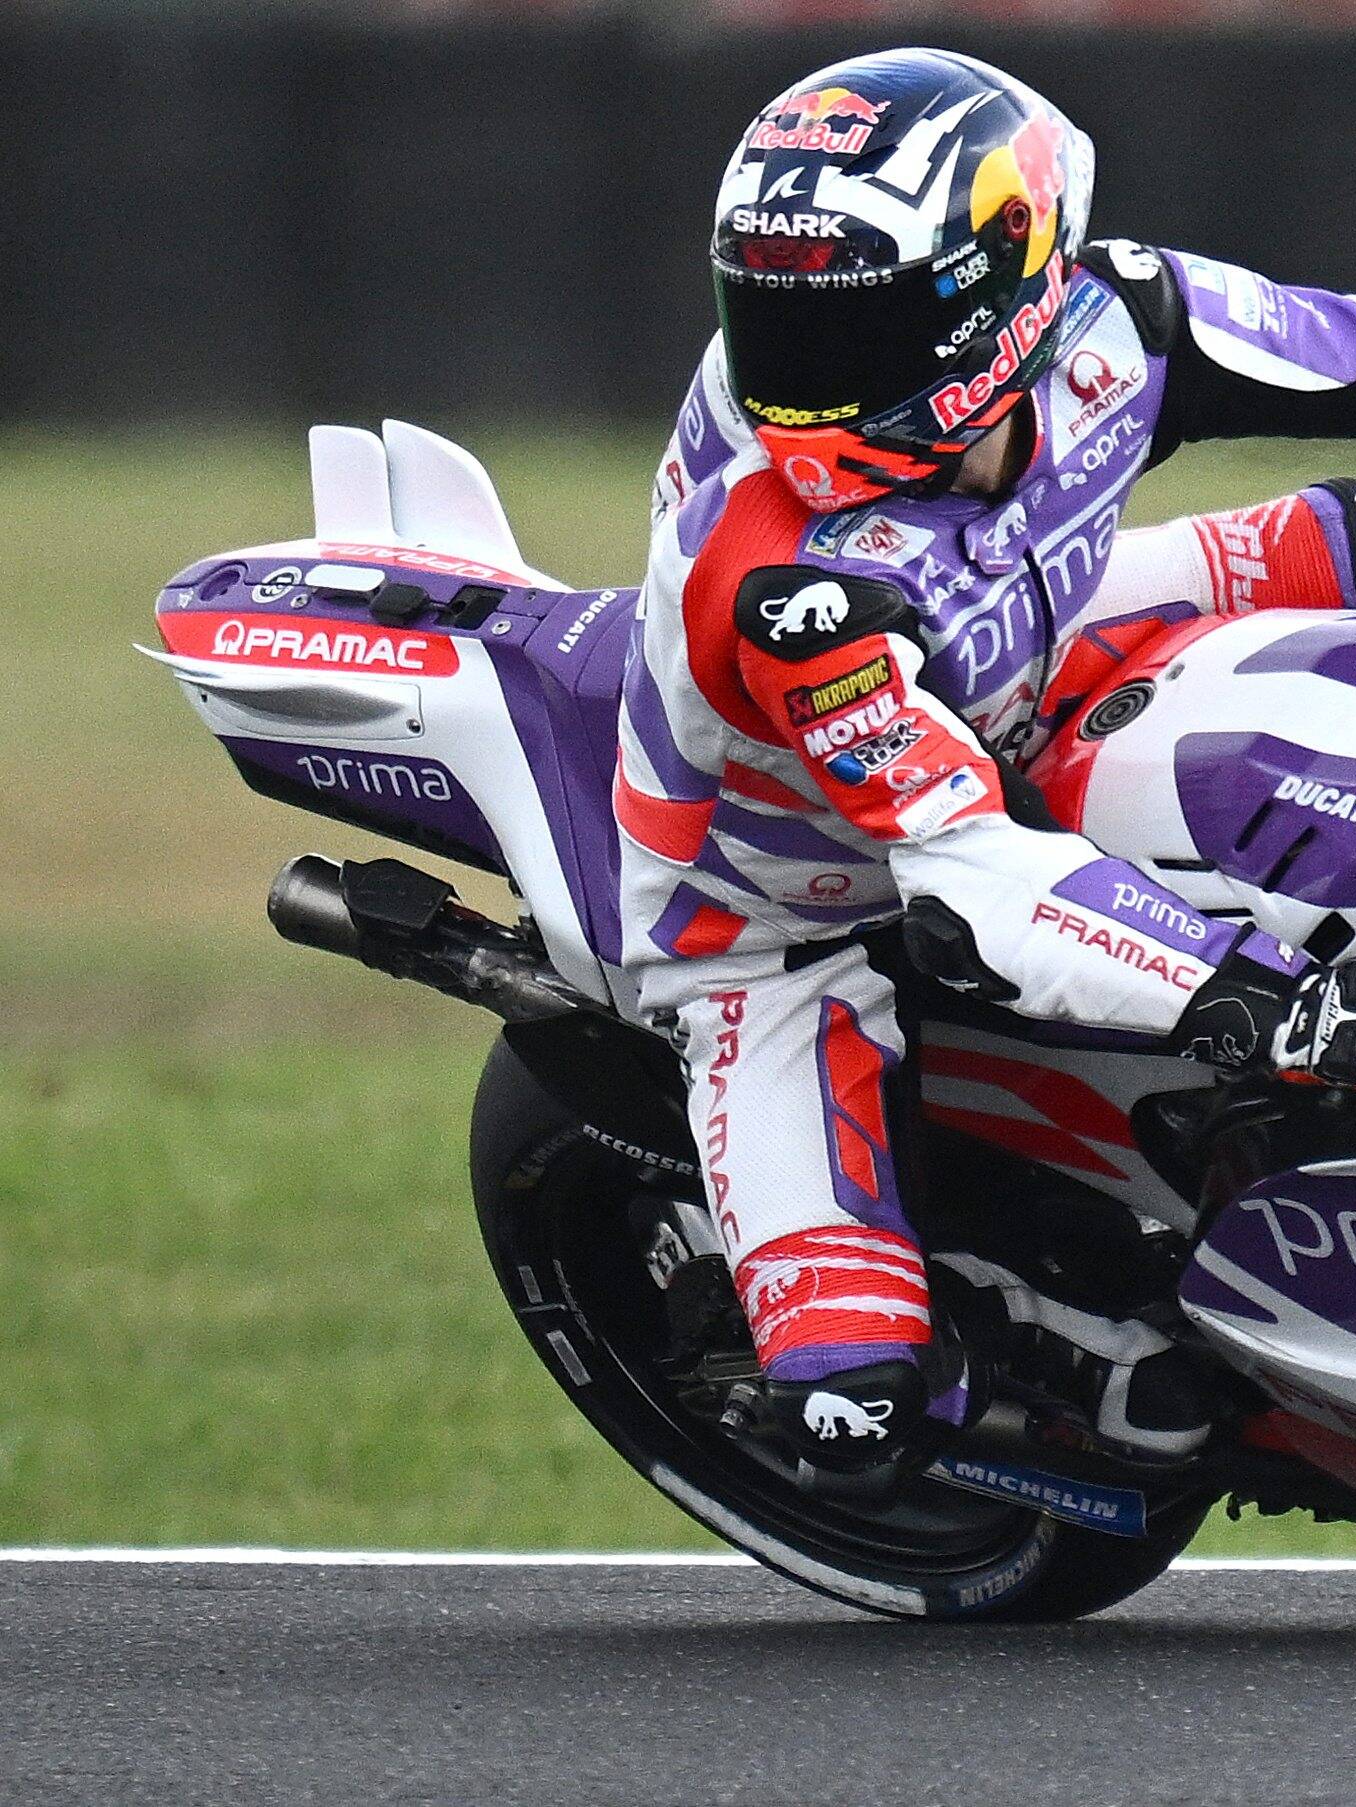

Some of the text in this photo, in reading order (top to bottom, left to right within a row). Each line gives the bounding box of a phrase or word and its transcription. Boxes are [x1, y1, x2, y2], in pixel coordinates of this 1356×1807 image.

[750, 121, 874, 155] Red Bull
[732, 209, 847, 239] SHARK
[754, 272, 796, 290] YOU
[806, 267, 895, 290] WINGS
[931, 239, 978, 273] SHARK
[928, 326, 1020, 435] Red
[1011, 248, 1065, 361] Bull
[1068, 367, 1143, 438] PRAMAC
[1081, 412, 1146, 476] april
[243, 629, 429, 670] PRAMAC
[556, 590, 619, 655] DUCATI
[803, 691, 900, 759] MOTUL
[860, 730, 928, 771] LOCK
[297, 754, 452, 802] prima
[1112, 881, 1207, 942] prima
[1030, 901, 1199, 993] PRAMAC
[704, 988, 750, 1248] PRAMAC
[954, 1461, 1120, 1520] MICHELIN
